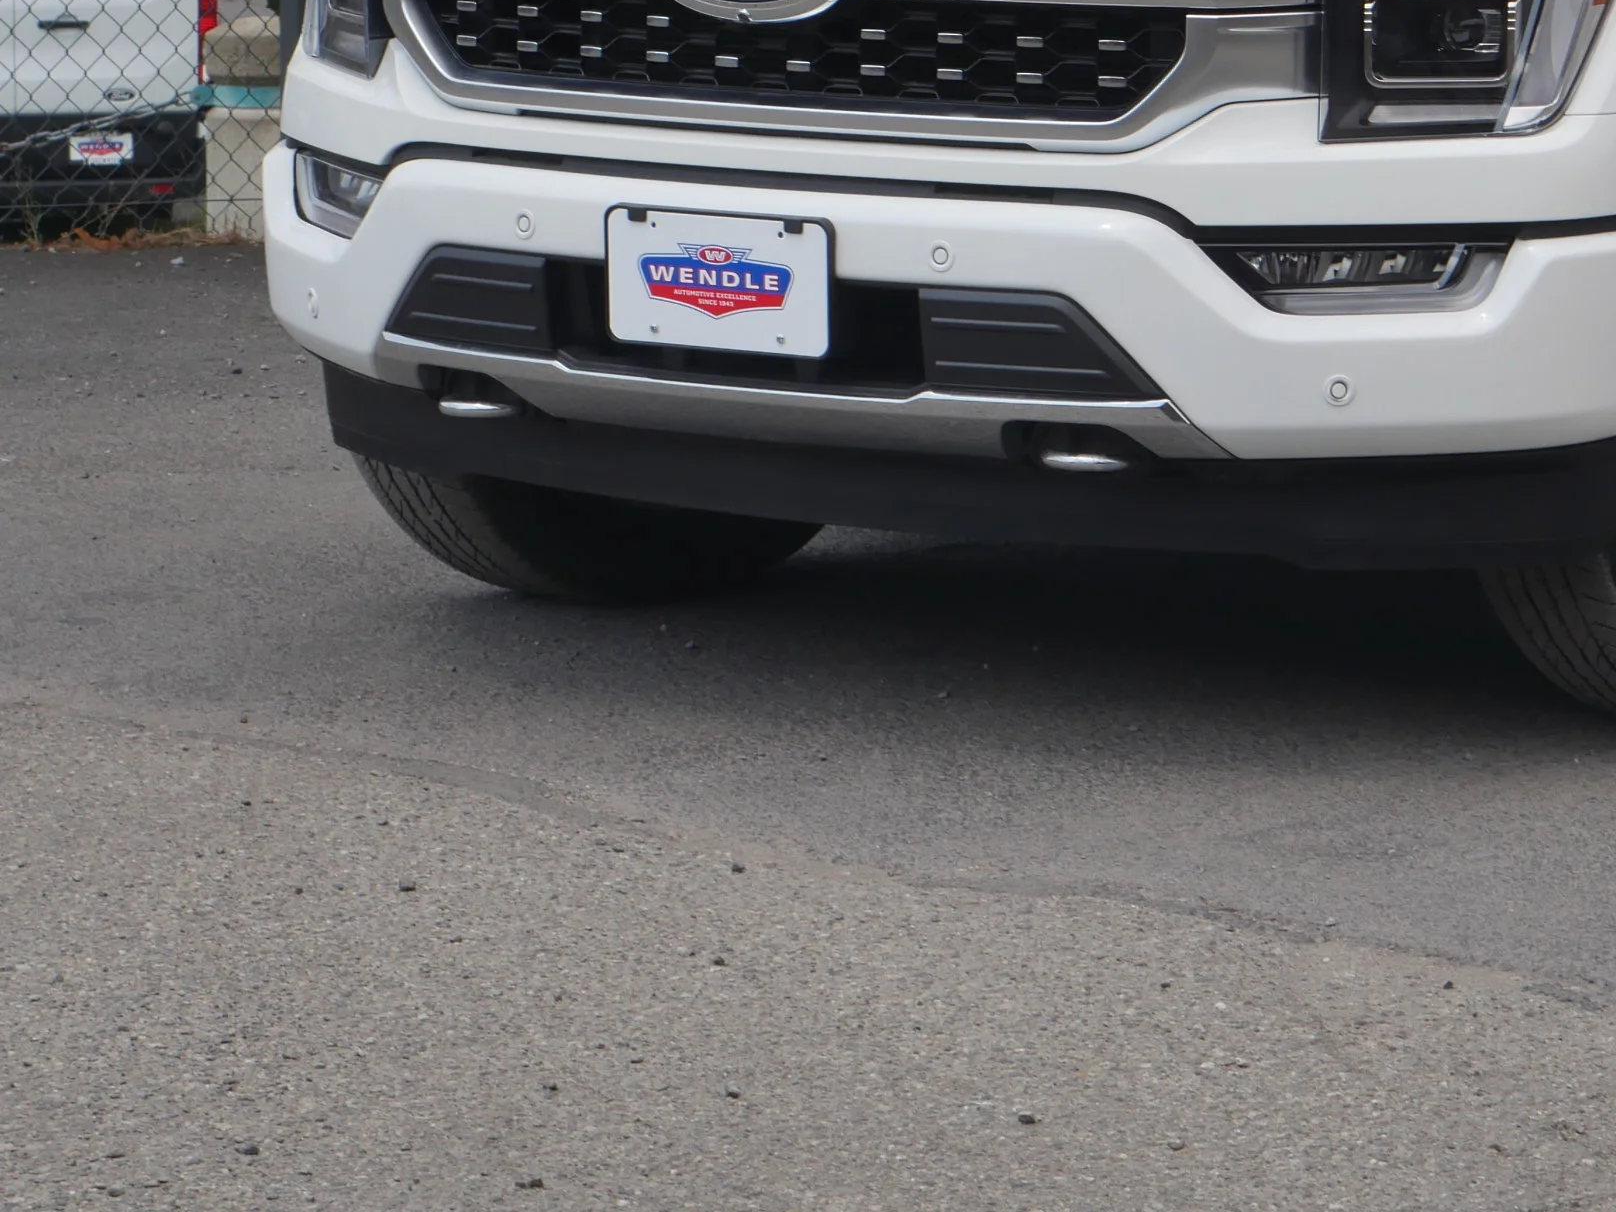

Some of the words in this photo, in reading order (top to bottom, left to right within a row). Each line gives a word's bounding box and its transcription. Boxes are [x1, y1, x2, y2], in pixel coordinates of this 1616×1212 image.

[704, 249, 726, 262] W
[648, 264, 780, 291] WENDLE
[673, 288, 715, 299] AUTOMOTIVE
[716, 292, 757, 302] EXCELLENCE
[698, 298, 718, 307] SINCE
